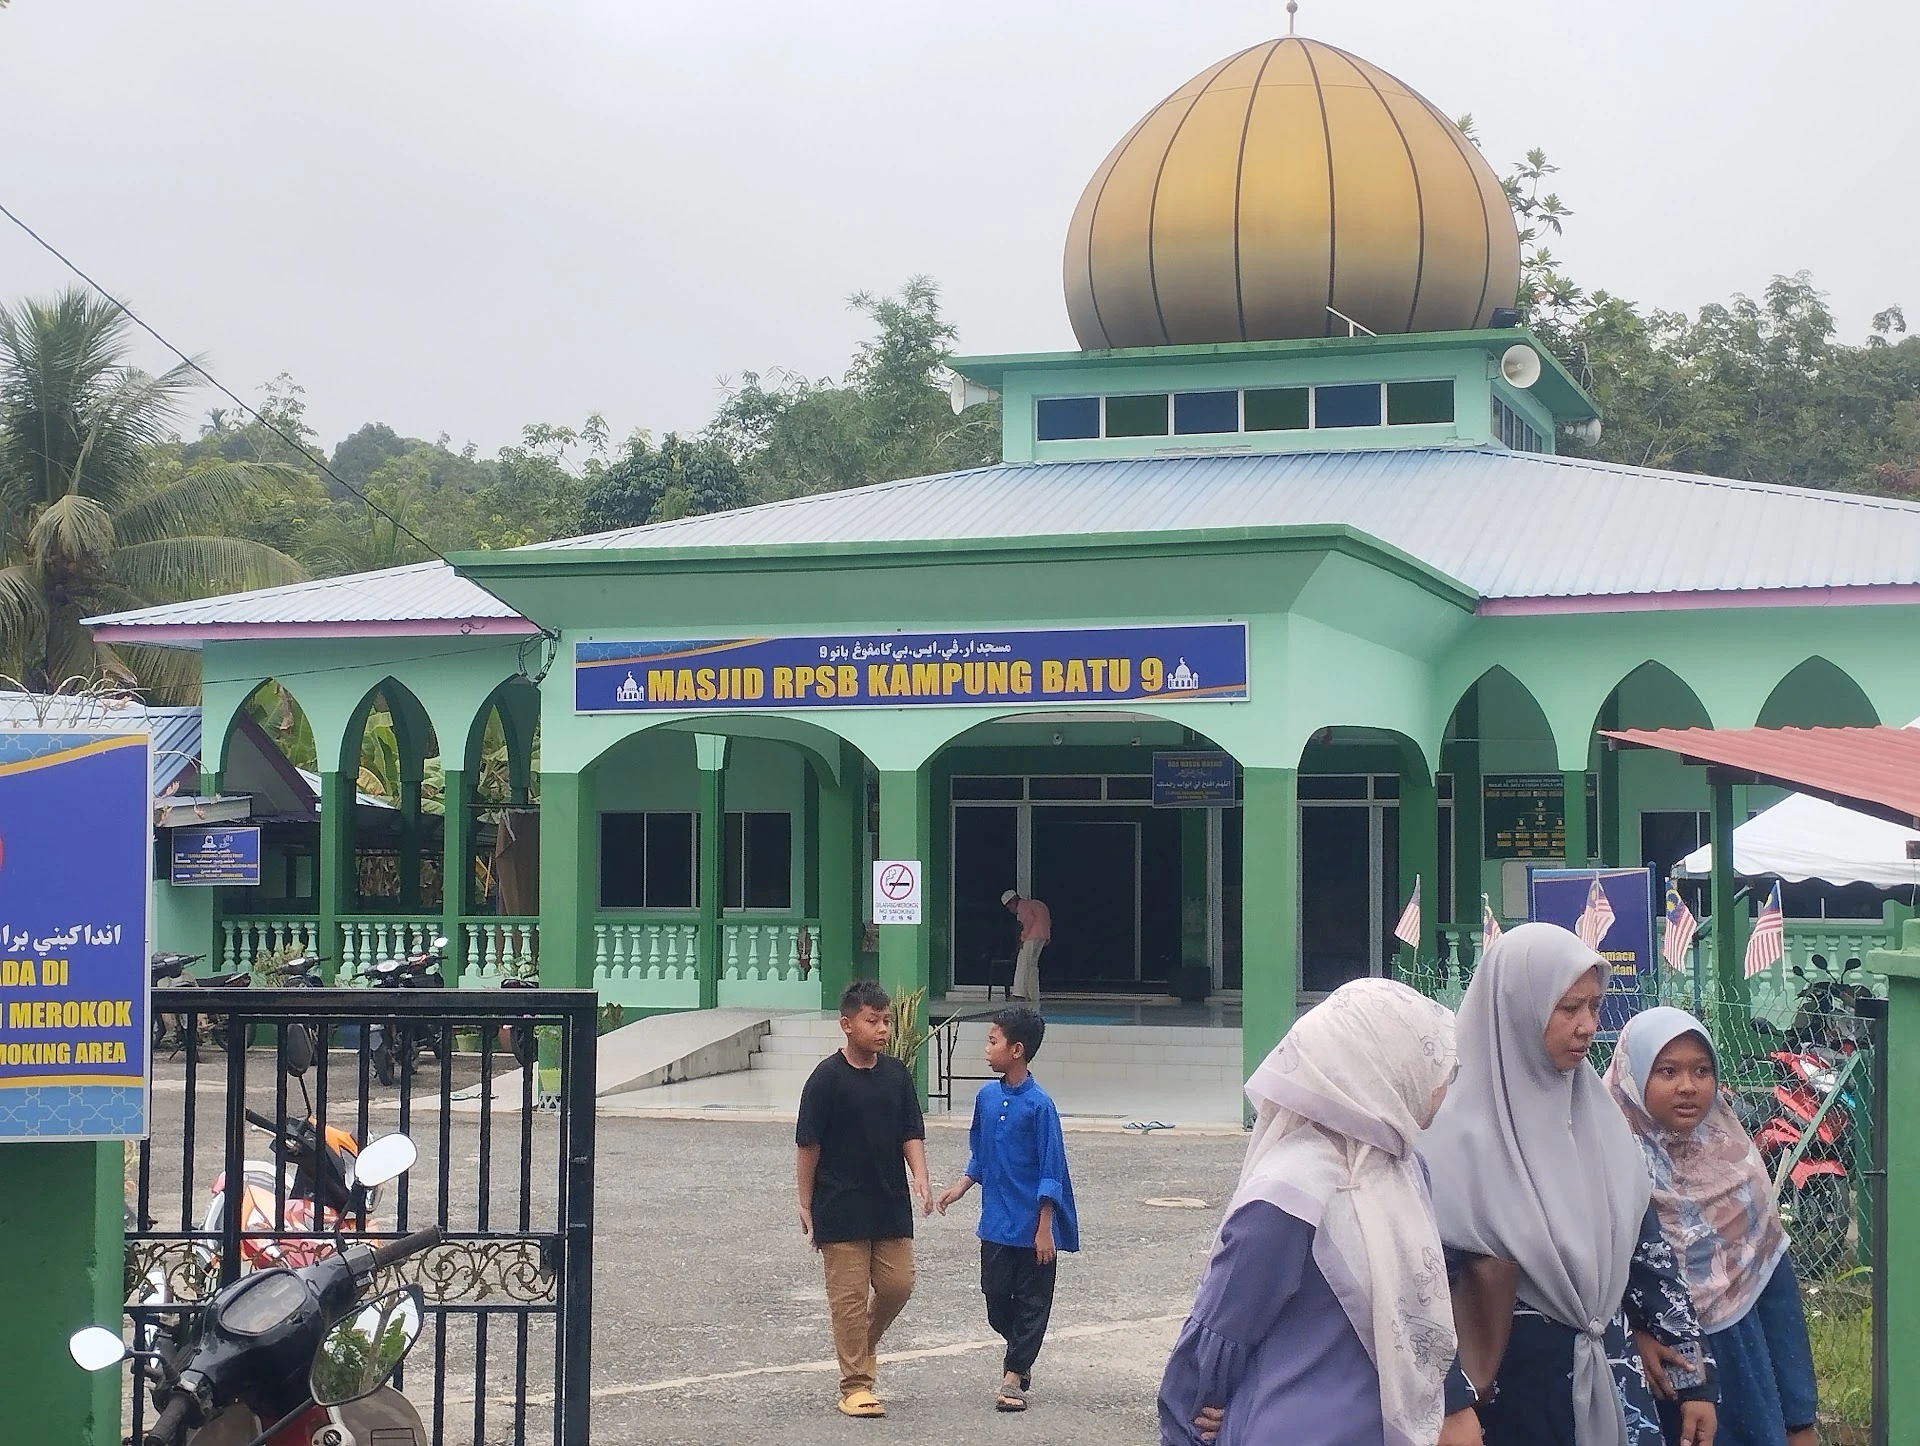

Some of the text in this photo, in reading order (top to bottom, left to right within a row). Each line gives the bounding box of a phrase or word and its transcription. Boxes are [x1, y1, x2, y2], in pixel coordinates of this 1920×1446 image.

[829, 645, 849, 662] باتو
[976, 642, 1011, 657] مسجد
[647, 657, 1164, 702] MASJID RPSB KAMPUNG BATU 9
[1, 924, 29, 952] برا
[0, 960, 68, 986] DA DI
[9, 1001, 131, 1029] MEROKOK
[74, 1041, 126, 1064] AREA
